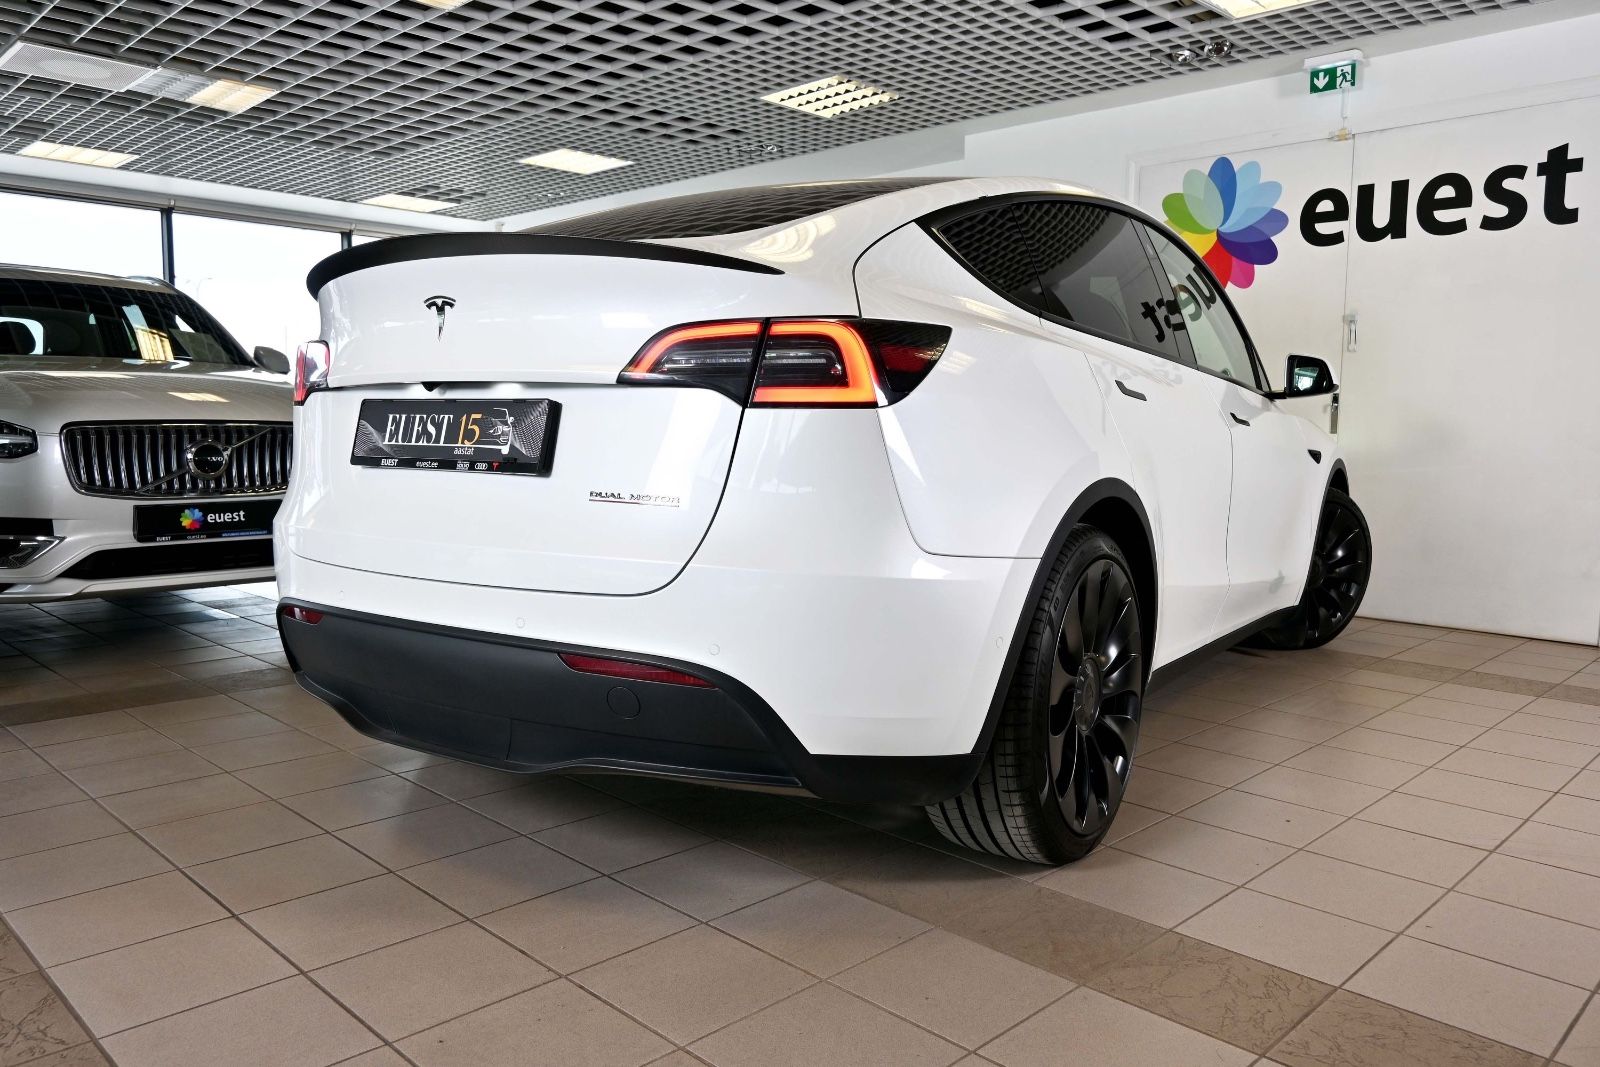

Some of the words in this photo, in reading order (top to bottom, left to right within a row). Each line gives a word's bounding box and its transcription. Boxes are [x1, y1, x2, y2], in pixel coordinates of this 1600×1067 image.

[1300, 142, 1584, 247] euest
[383, 413, 453, 444] EUEST
[457, 413, 482, 445] 15
[453, 446, 474, 455] aastat
[380, 458, 399, 467] EUEST
[589, 491, 626, 500] DUAL
[207, 510, 246, 523] euest
